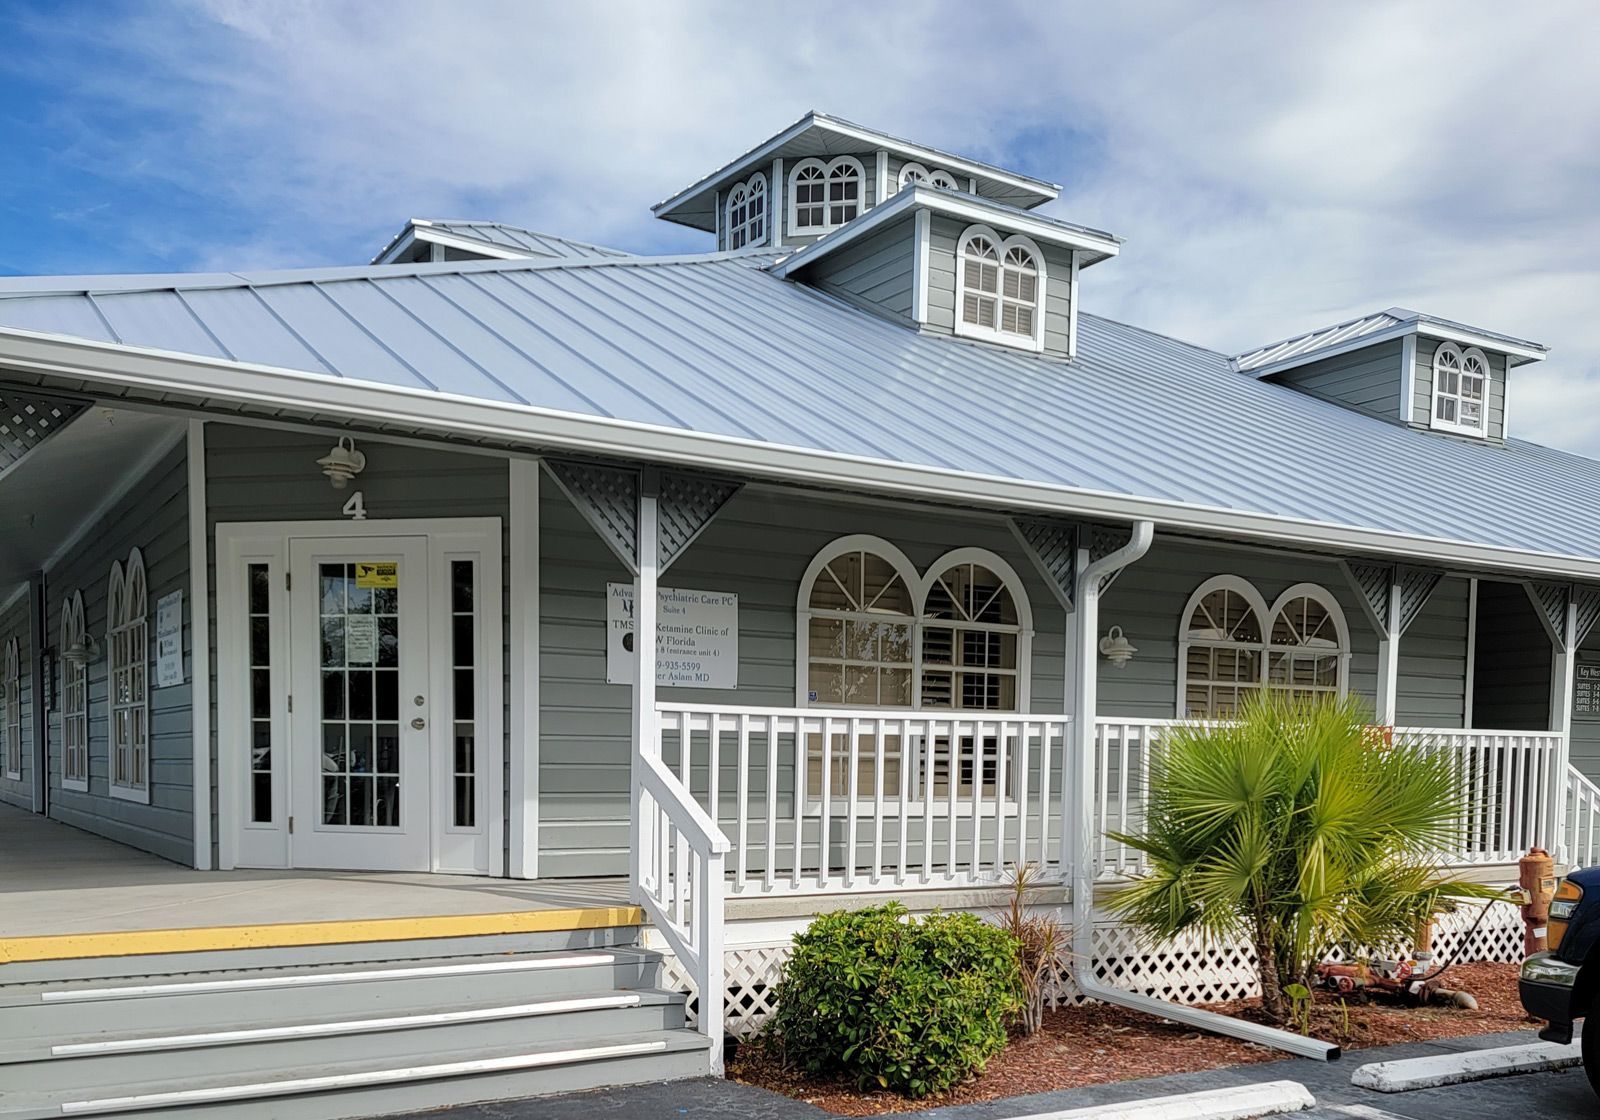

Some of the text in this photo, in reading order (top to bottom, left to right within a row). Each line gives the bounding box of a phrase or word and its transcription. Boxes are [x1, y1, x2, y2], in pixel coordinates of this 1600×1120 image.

[343, 491, 367, 520] 4
[701, 594, 719, 605] Care
[721, 596, 734, 606] PC
[663, 605, 686, 615] Suite 4
[613, 619, 729, 637] TMS Ketamine Clinic of
[666, 636, 696, 647] Florida
[666, 646, 697, 656] (entrance
[698, 649, 711, 657] unit
[713, 649, 720, 657] 4)
[657, 660, 701, 671] 9-935-5599
[668, 671, 693, 681] Aslam
[695, 673, 710, 682] MD
